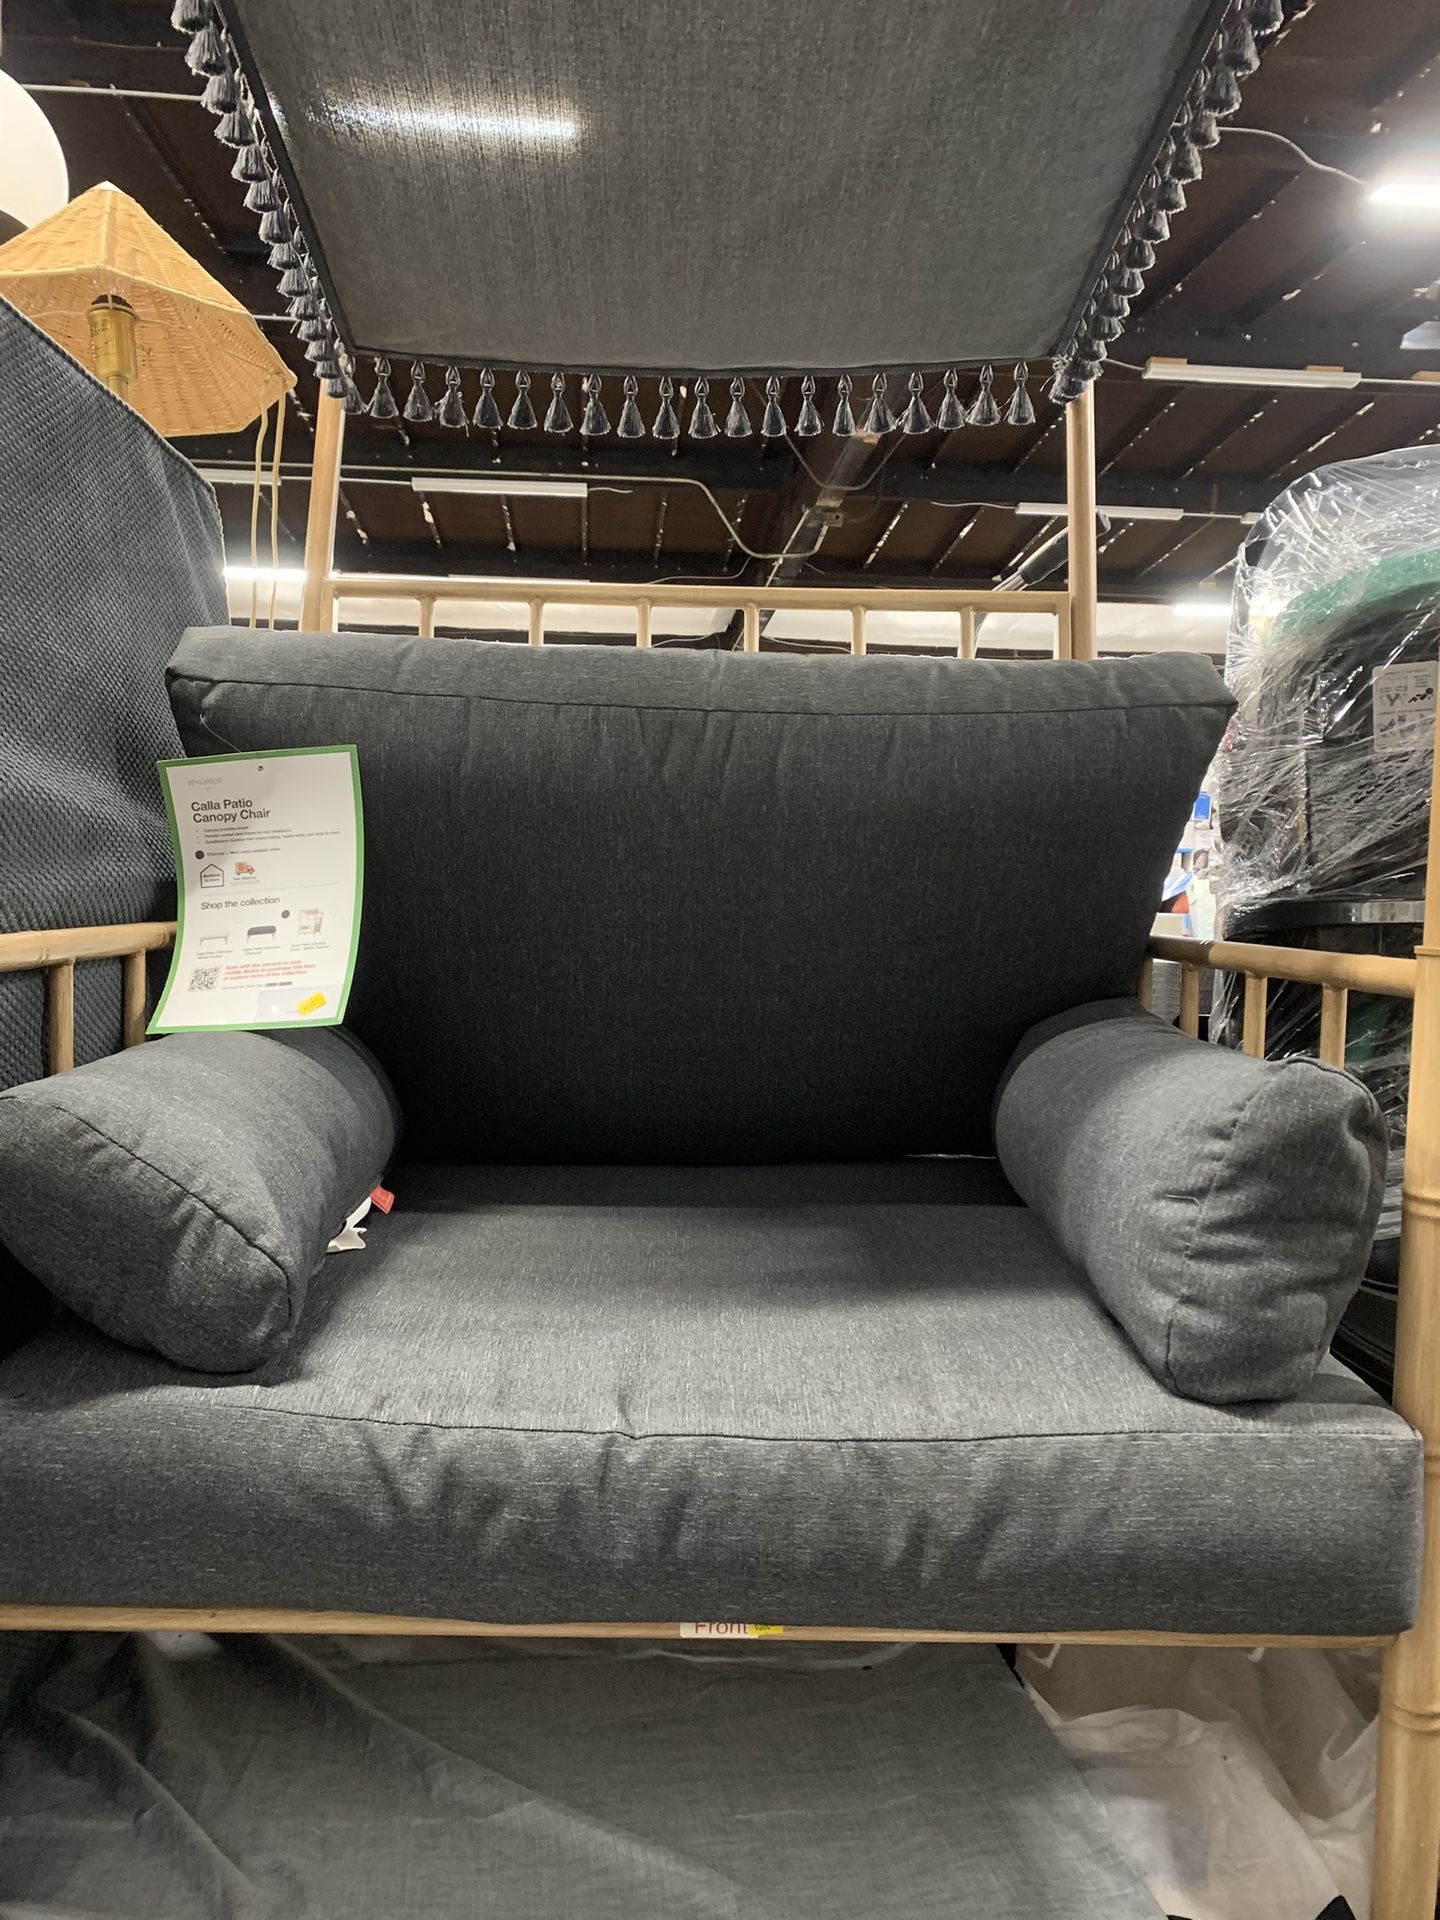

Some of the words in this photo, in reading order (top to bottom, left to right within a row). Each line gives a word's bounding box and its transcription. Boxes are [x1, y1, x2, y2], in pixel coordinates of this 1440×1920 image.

[190, 800, 221, 812] Calla
[223, 798, 253, 810] Patio
[192, 812, 238, 823] Canopy
[240, 808, 271, 820] Chair
[200, 901, 223, 911] Shop
[224, 900, 239, 908] the
[240, 896, 280, 907] collection
